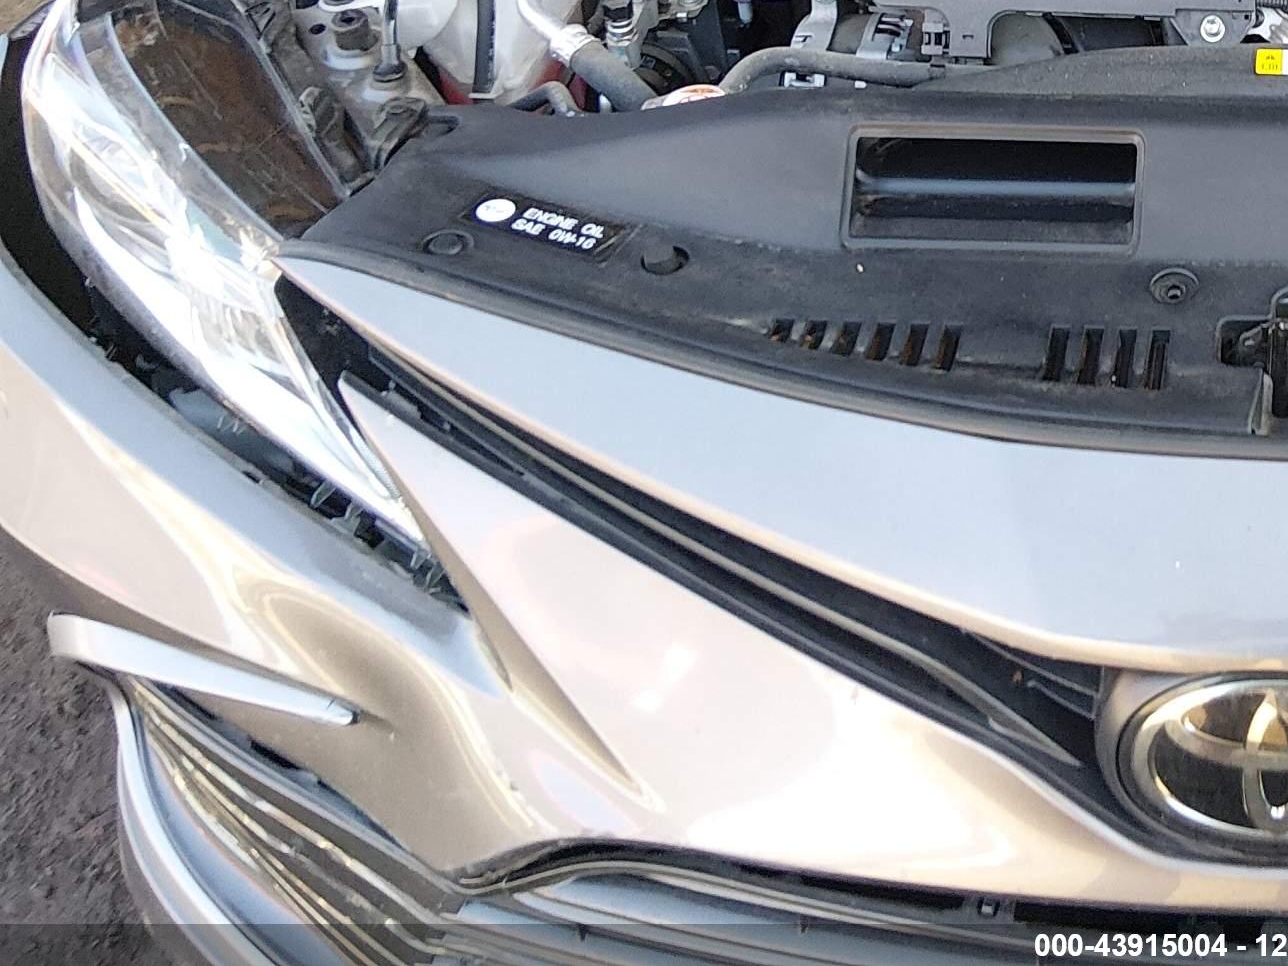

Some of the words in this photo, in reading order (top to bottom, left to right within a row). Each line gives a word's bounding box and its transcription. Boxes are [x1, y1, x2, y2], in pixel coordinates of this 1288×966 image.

[511, 219, 545, 235] SAE
[548, 230, 596, 249] 0W-16
[522, 207, 579, 230] ENGINE
[581, 223, 605, 238] OIL
